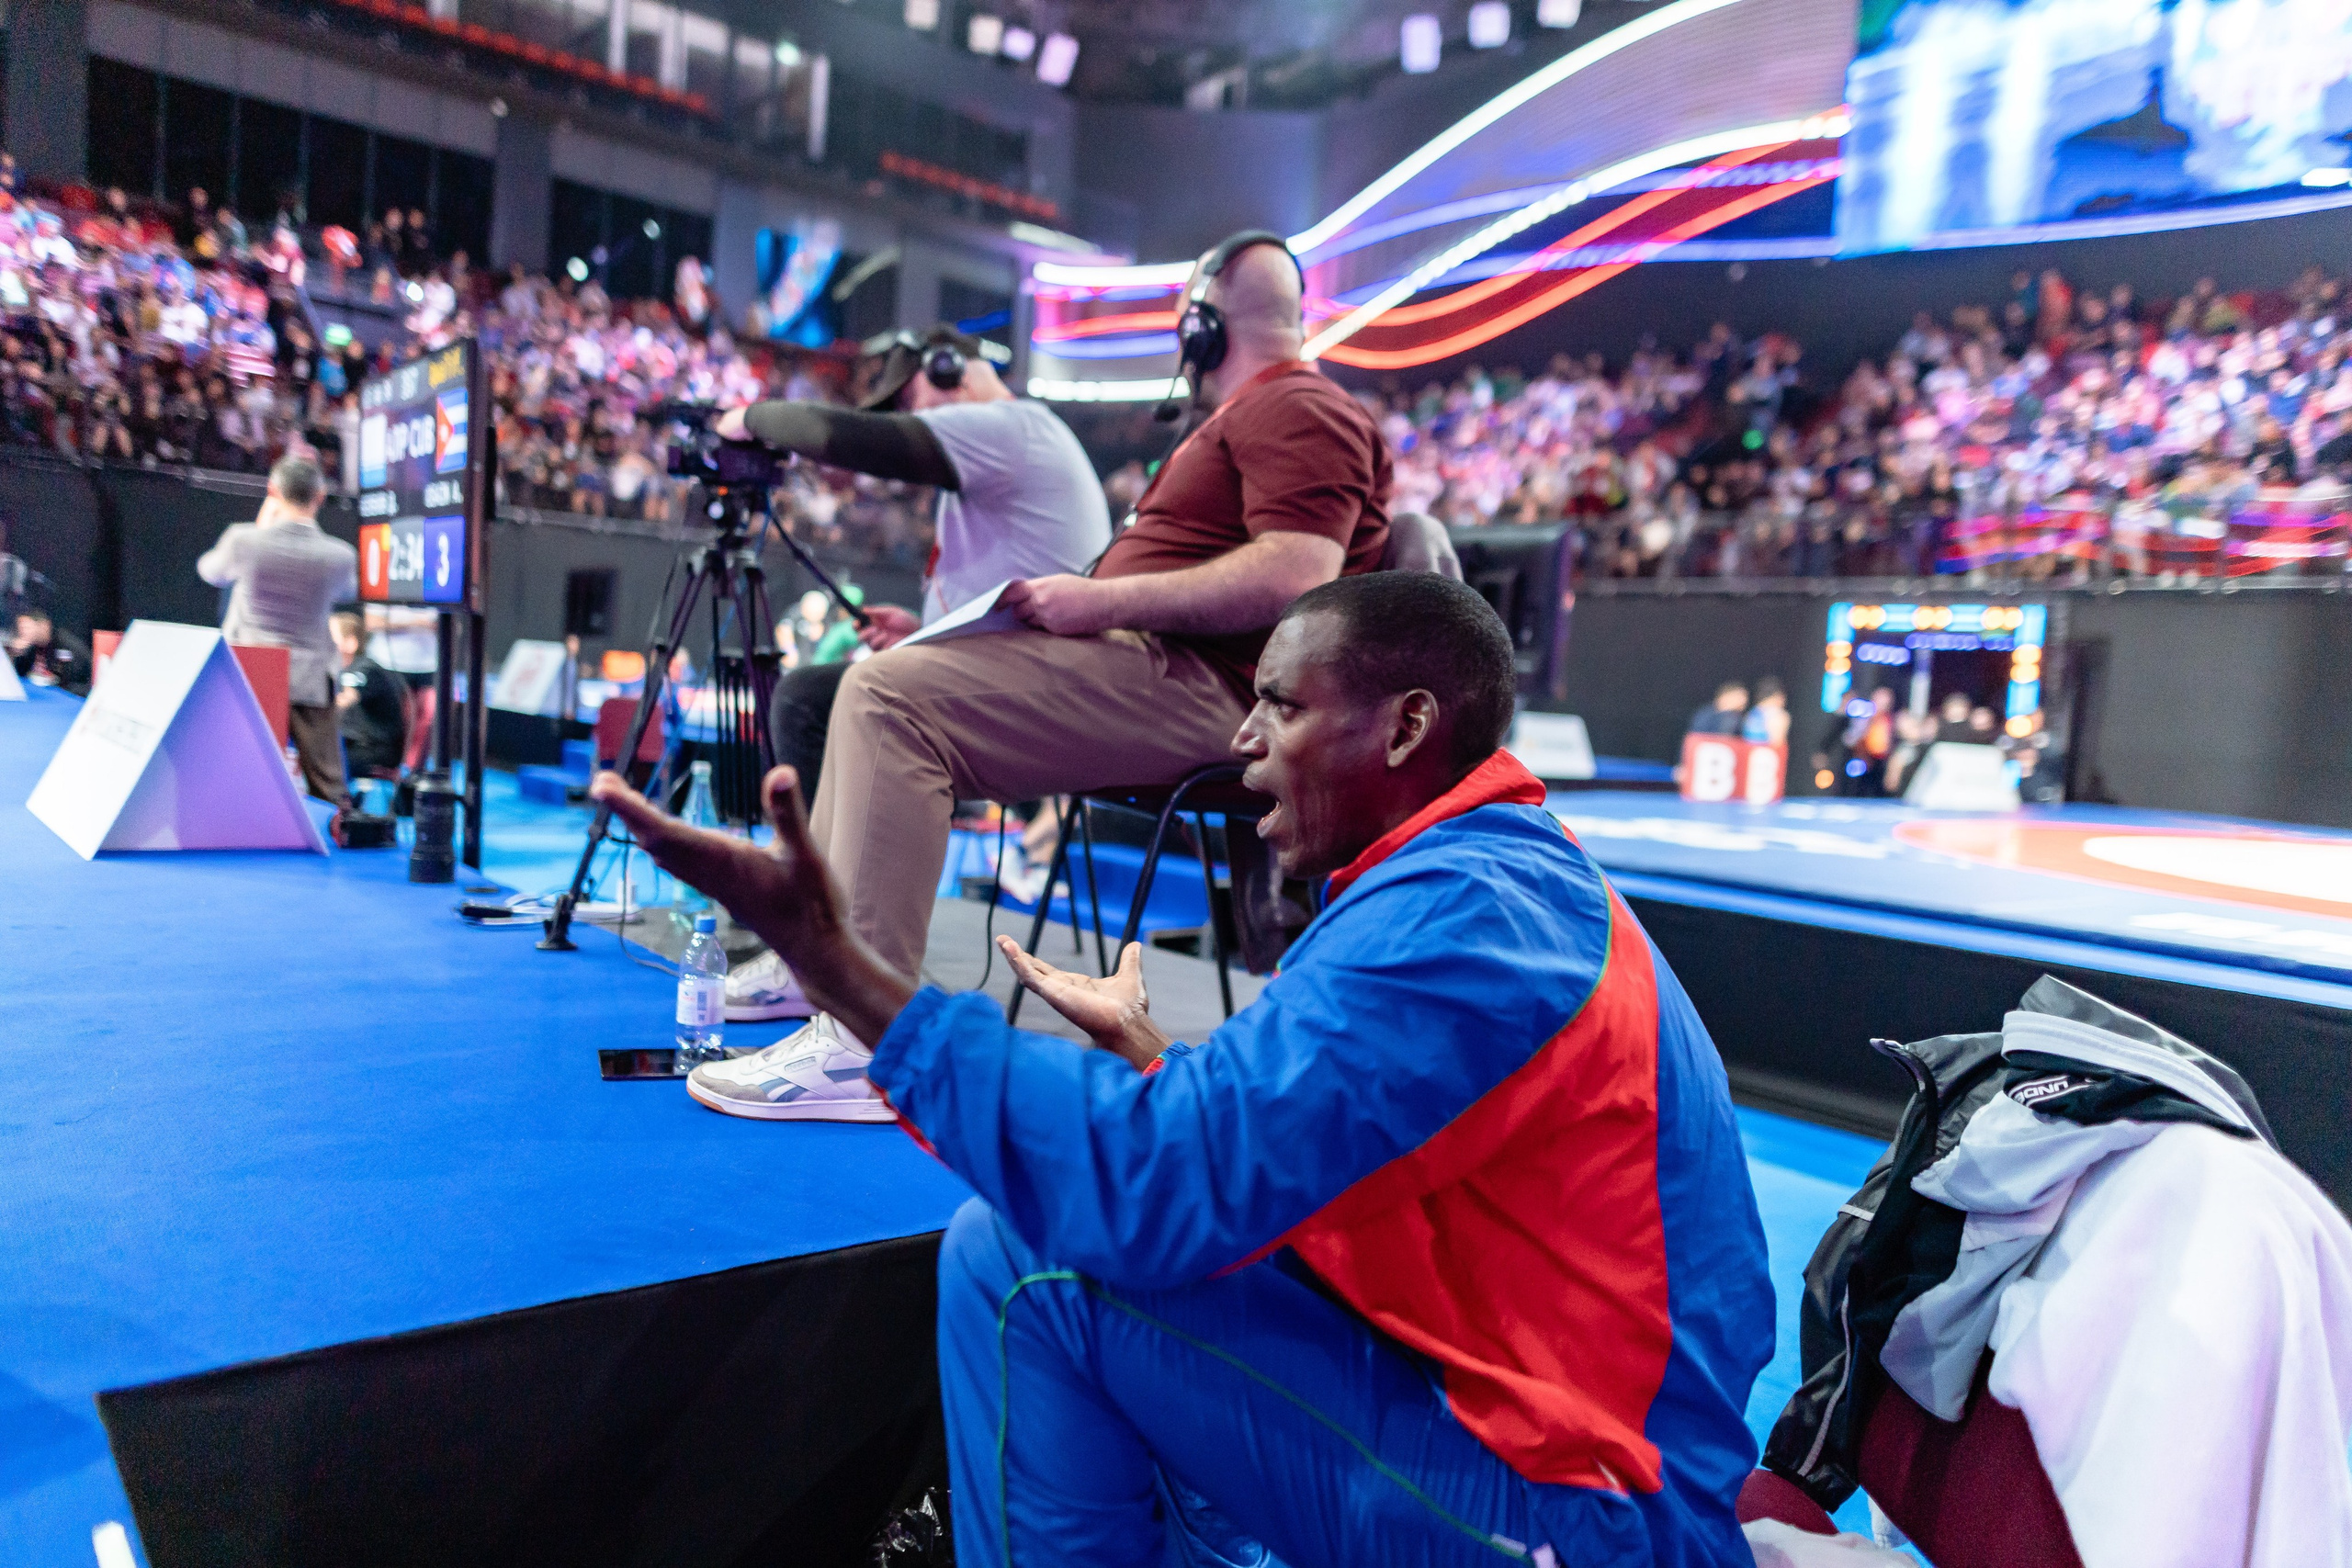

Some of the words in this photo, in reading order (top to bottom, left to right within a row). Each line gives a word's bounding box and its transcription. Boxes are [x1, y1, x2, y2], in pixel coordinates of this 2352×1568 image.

[368, 538, 380, 587] 0
[436, 535, 450, 587] 3
[1691, 741, 1736, 802] B
